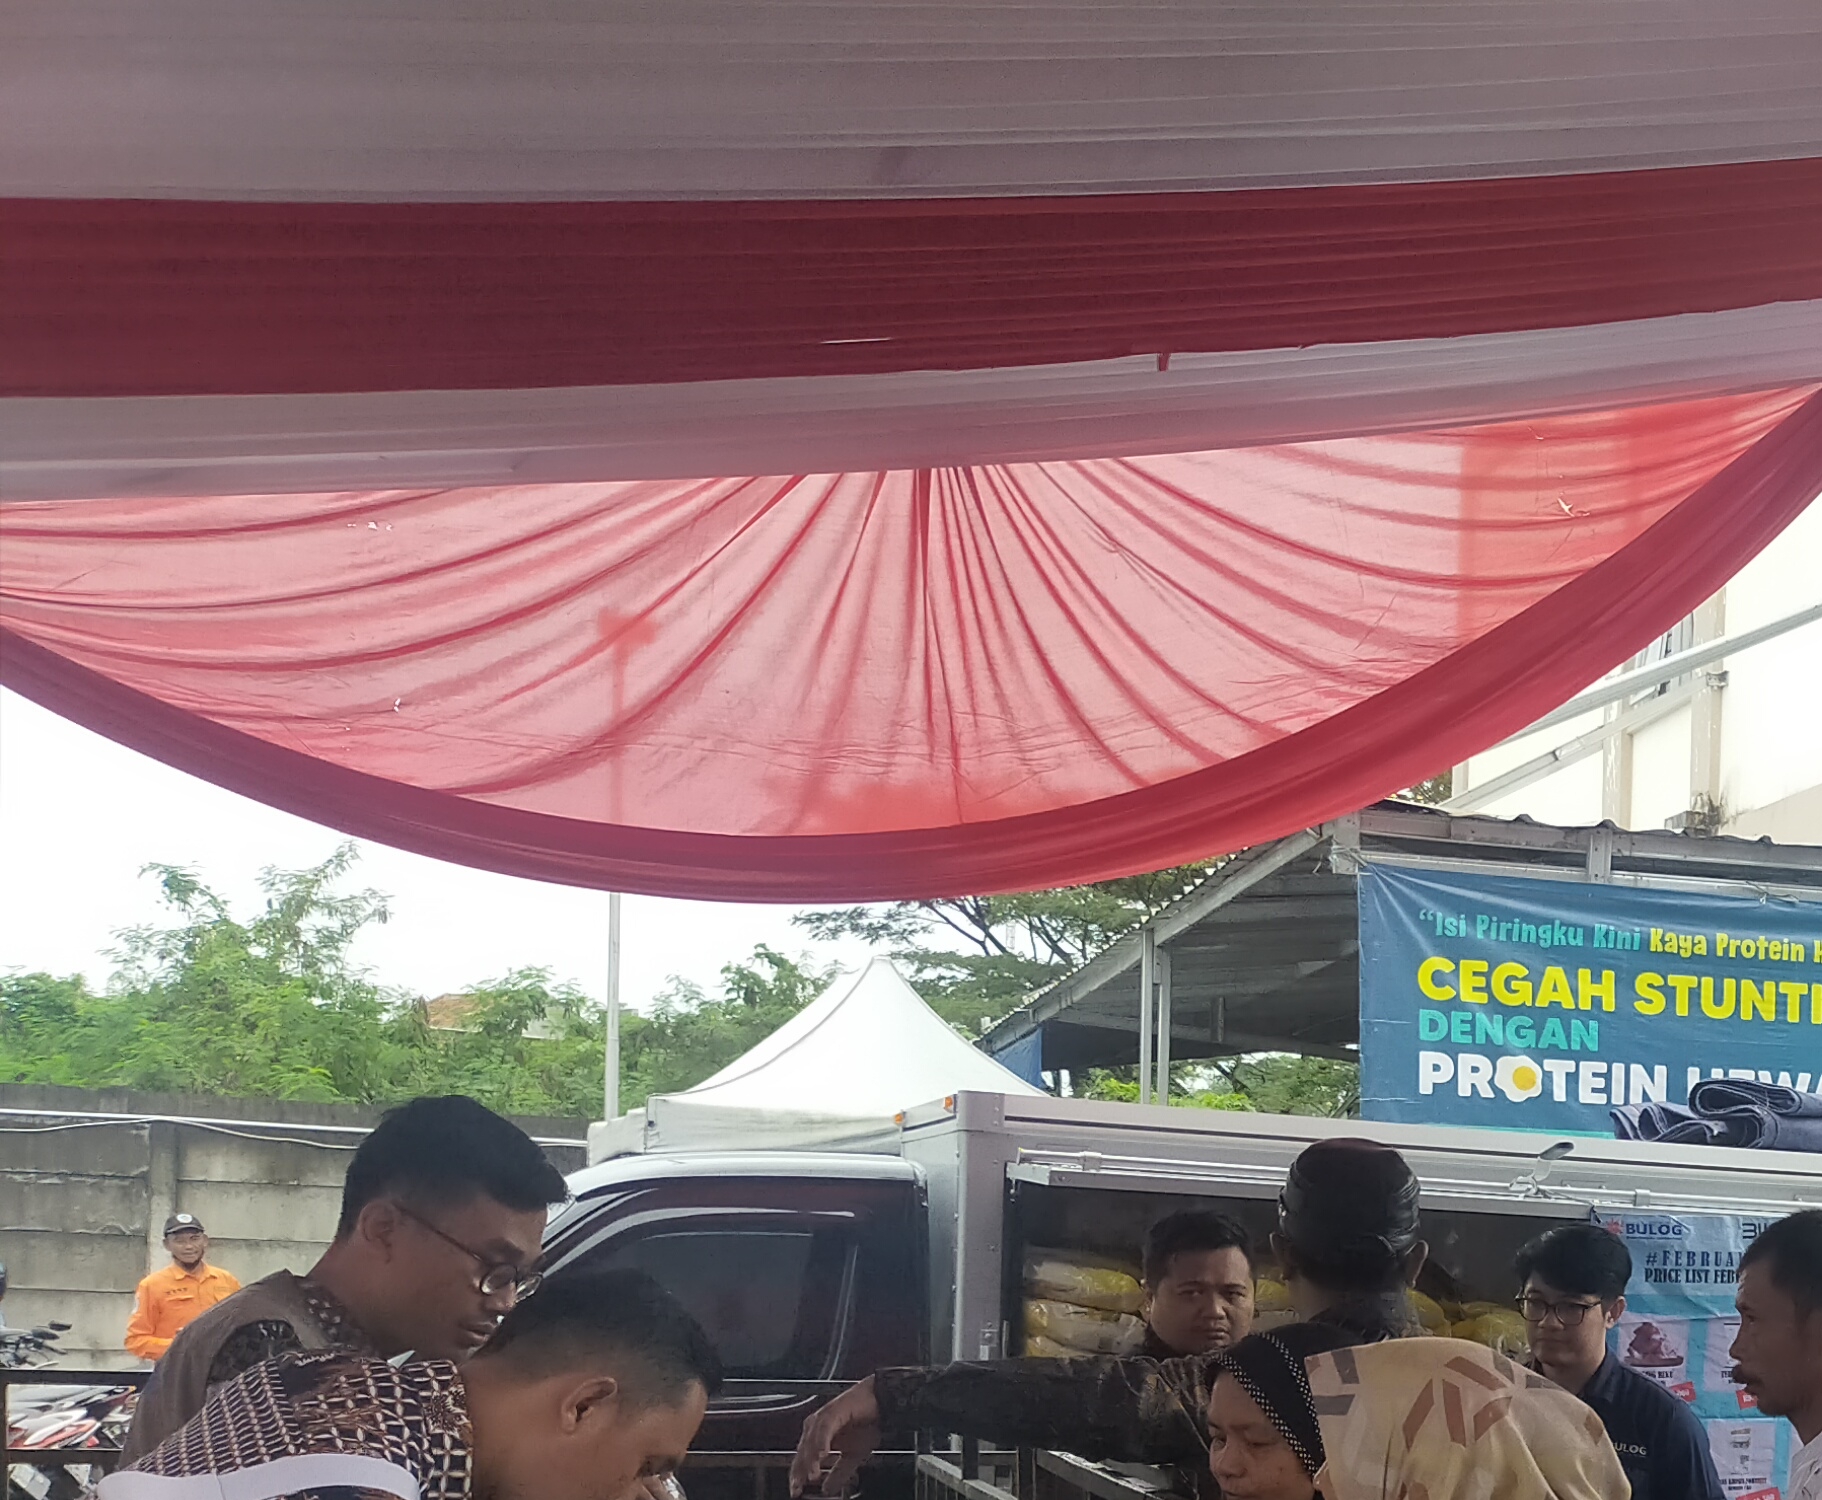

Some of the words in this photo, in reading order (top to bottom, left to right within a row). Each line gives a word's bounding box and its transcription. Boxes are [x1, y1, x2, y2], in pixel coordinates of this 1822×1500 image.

[1476, 914, 1584, 949] Piringku
[1593, 923, 1641, 951] Kini
[1650, 927, 1707, 958] Kaya
[1716, 933, 1805, 963] Protein
[1417, 956, 1616, 1012] CEGAH
[1418, 1008, 1599, 1052] DENGAN
[1418, 1050, 1668, 1106] PROTEIN
[1625, 1222, 1683, 1236] BULOG
[1644, 1267, 1682, 1284] PRICE
[1685, 1268, 1710, 1284] LIST
